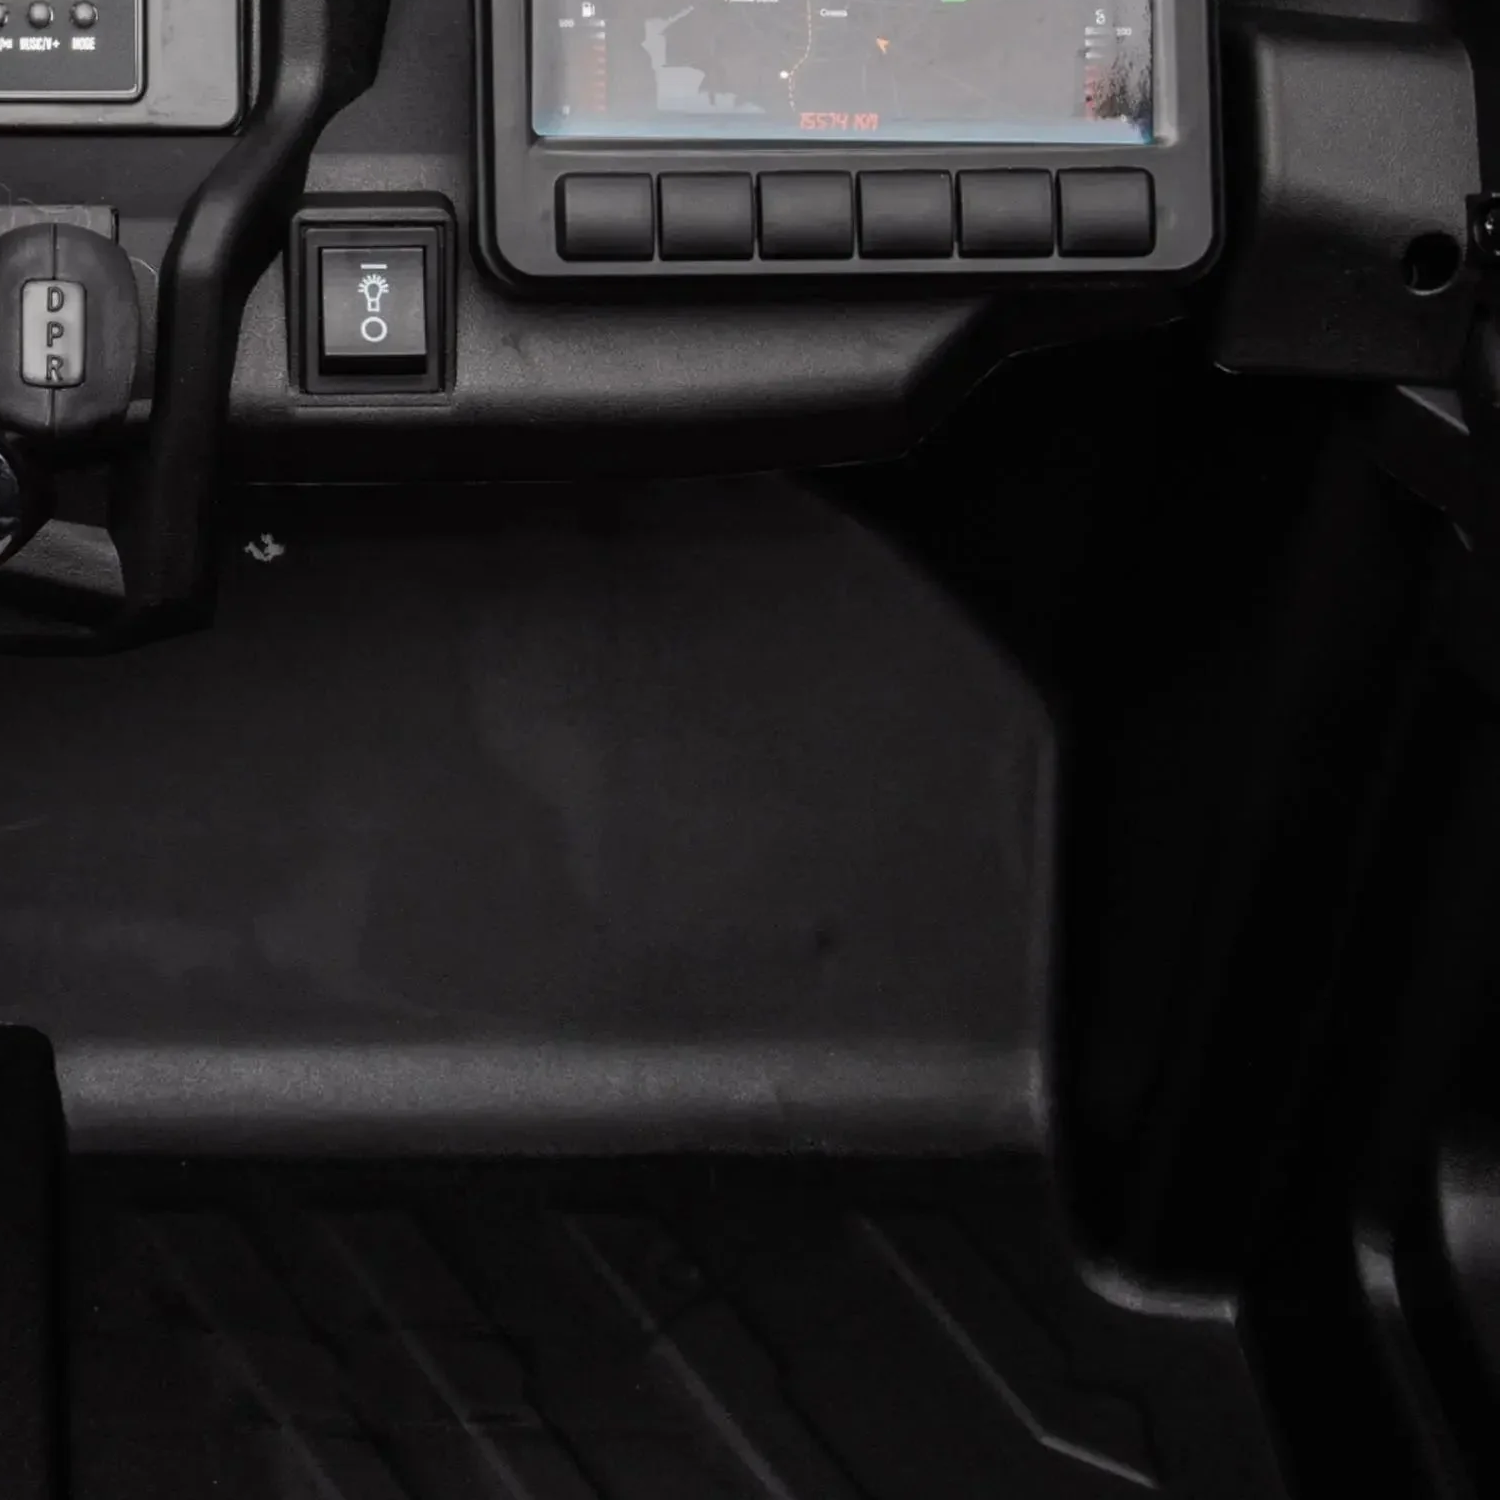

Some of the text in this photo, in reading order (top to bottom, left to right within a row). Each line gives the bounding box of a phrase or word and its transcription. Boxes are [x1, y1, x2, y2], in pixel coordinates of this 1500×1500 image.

[47, 286, 64, 312] D
[46, 321, 64, 348] P
[46, 354, 64, 381] R
